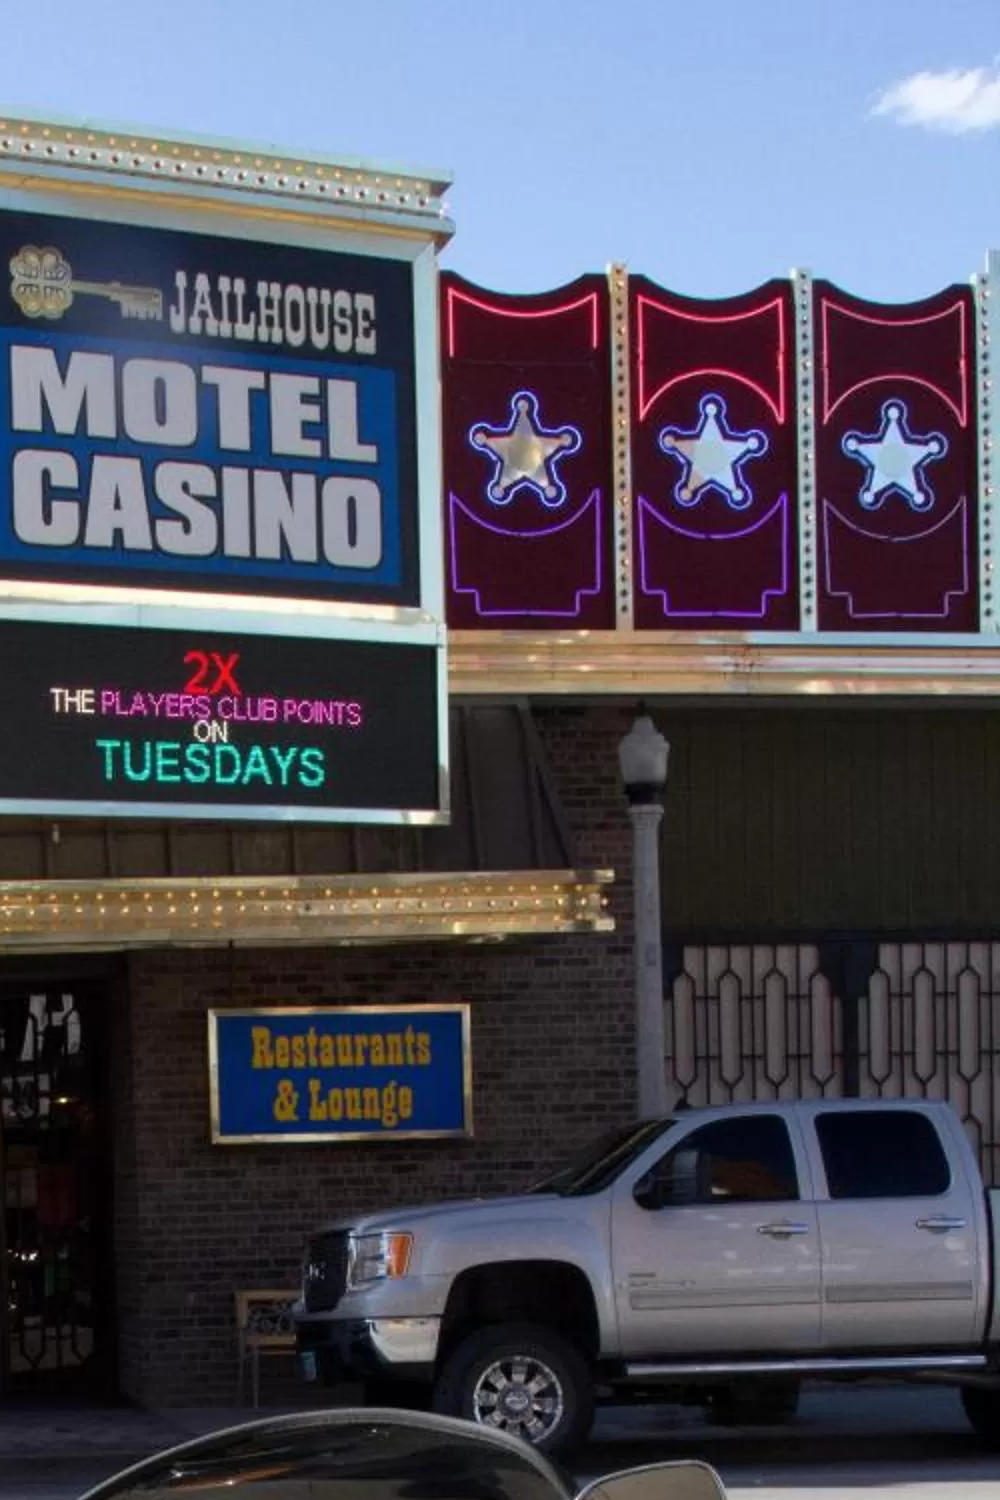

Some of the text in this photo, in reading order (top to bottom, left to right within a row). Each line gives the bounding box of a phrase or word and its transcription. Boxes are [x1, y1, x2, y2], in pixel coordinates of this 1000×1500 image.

[169, 271, 376, 354] JAILHOUSE
[9, 345, 378, 462] MOTEL
[12, 449, 382, 569] CASINO
[183, 651, 241, 695] 2X
[50, 688, 361, 726] THE PLAYERS CLUB POINTS
[193, 719, 228, 743] ON
[96, 740, 325, 787] TUESDAYS
[252, 1024, 431, 1069] Restaurants
[274, 1079, 413, 1127] & Lounge
